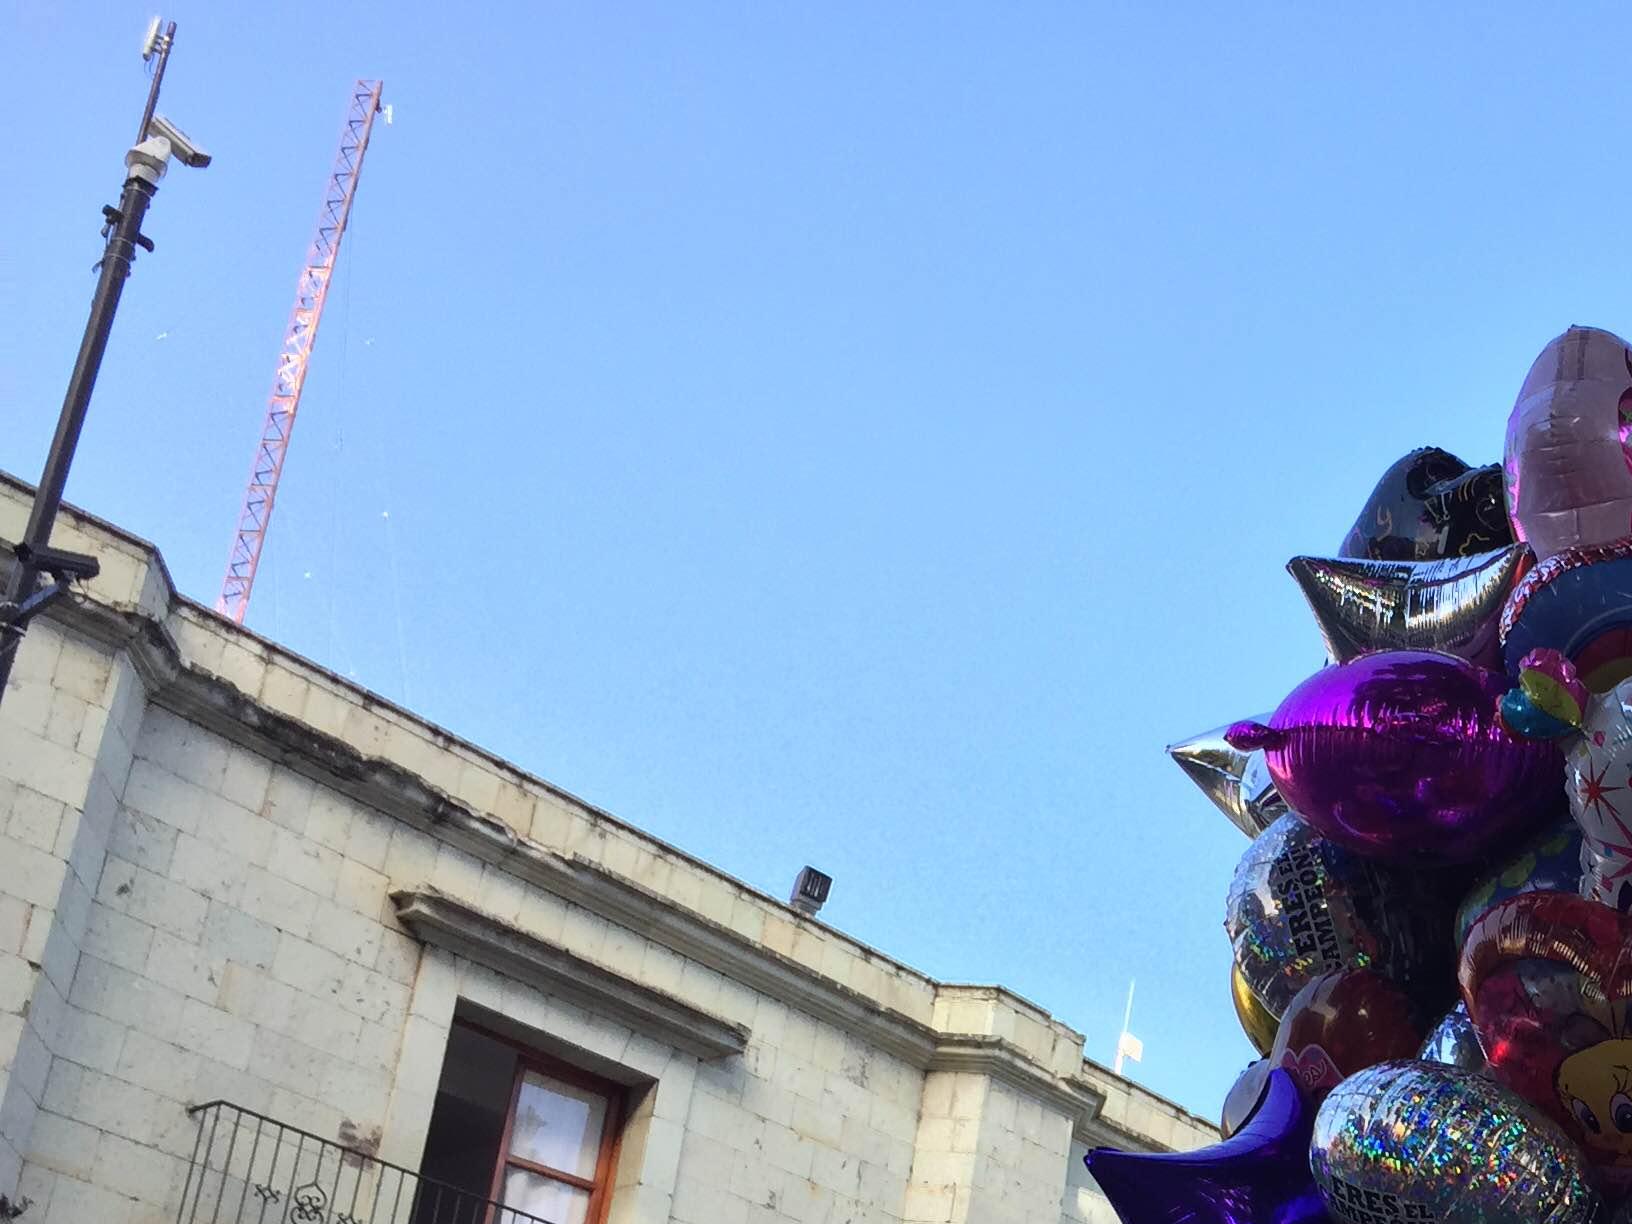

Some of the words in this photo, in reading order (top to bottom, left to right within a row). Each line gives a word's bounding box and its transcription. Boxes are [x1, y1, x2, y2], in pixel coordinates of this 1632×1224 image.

[1276, 877, 1318, 957] ERES
[1330, 1174, 1401, 1216] ERES
[1403, 1202, 1435, 1220] EL
